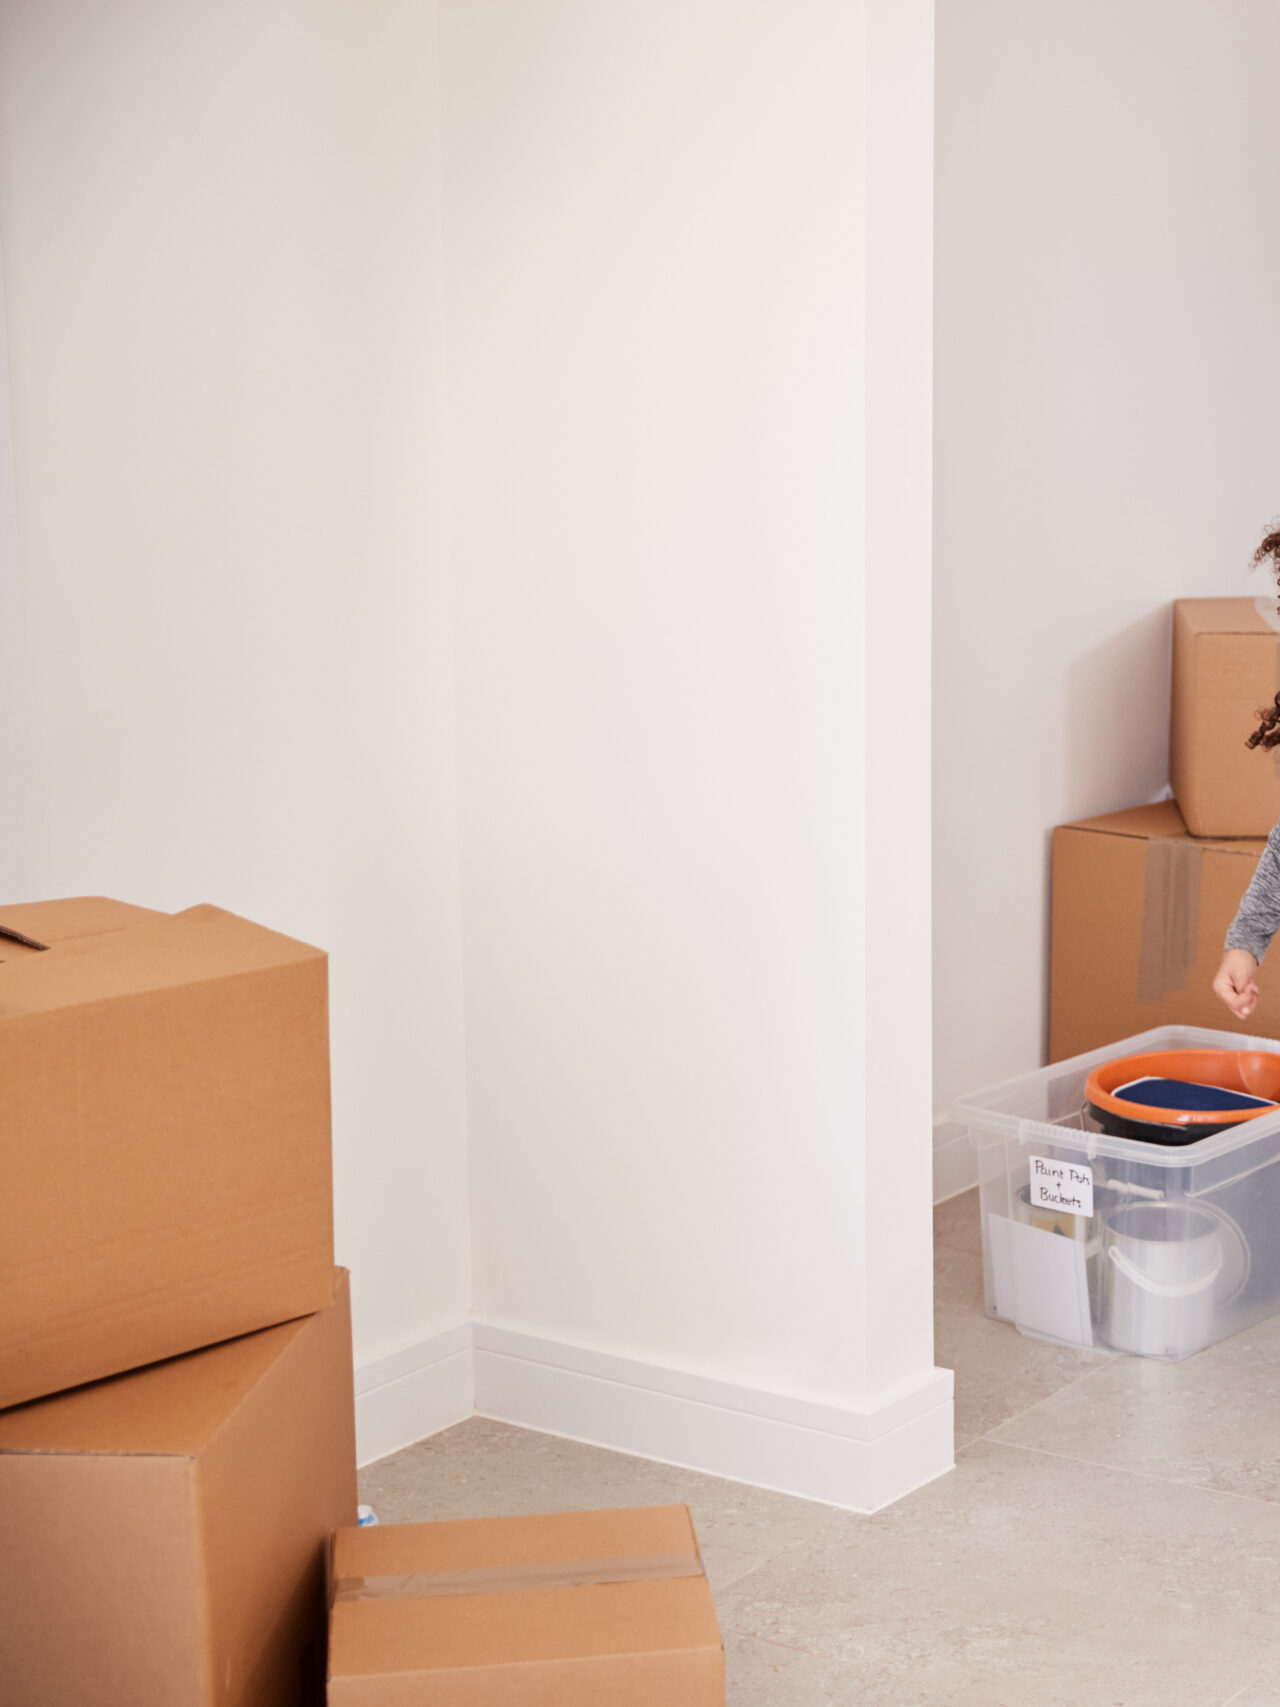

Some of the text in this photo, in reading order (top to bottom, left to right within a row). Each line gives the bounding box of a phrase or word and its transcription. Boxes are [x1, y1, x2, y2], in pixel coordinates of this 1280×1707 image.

[1035, 1160, 1090, 1185] Paint Pots
[1040, 1187, 1081, 1208] Buckets
